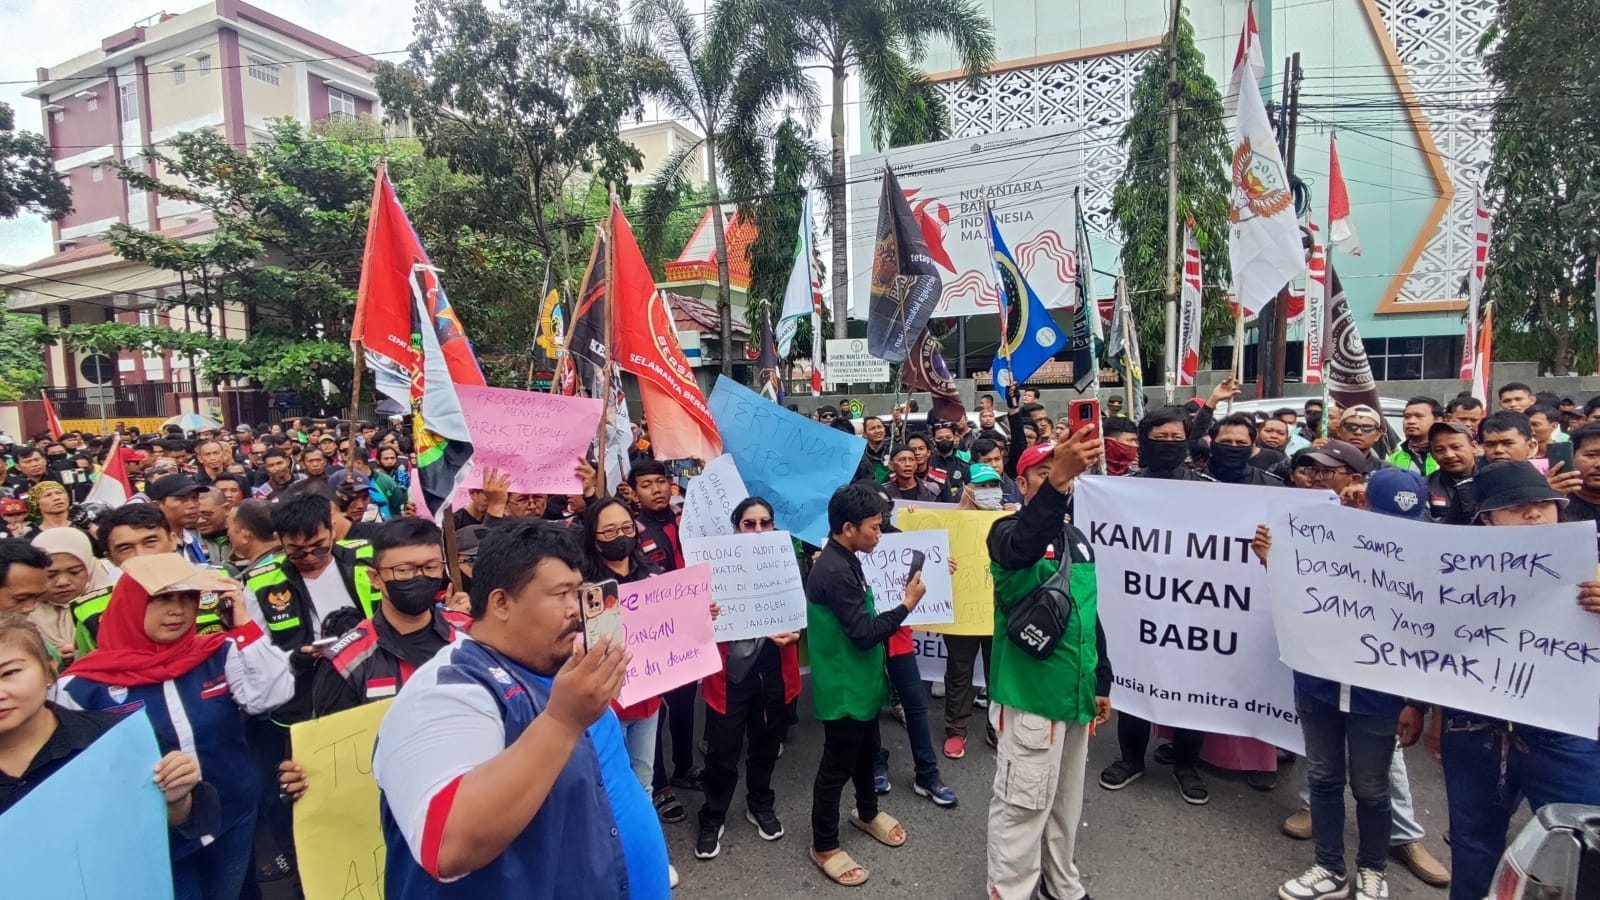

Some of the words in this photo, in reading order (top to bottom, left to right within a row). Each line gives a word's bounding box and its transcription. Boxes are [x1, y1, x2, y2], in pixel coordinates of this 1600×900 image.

[960, 210, 1034, 229] INDNESIA
[960, 230, 986, 241] MA
[1310, 297, 1319, 365] DIRGAHAYU
[629, 353, 683, 395] SELAMANYA
[690, 545, 743, 561] TOLONG
[1090, 520, 1173, 555] KAMI
[1186, 532, 1254, 564] MIT
[856, 547, 897, 569] arga
[711, 565, 747, 576] IKATOR
[1123, 570, 1251, 612] BUKAN
[1371, 567, 1424, 605] Masih
[719, 604, 746, 617] EMO
[755, 601, 786, 613] BOLEH
[743, 617, 784, 630] JANGAN
[1390, 607, 1435, 639] Yang
[330, 631, 361, 653] DRIVER
[1139, 618, 1238, 656] BABU
[912, 639, 948, 659] BEL
[1112, 673, 1145, 694] usia
[1149, 684, 1182, 702] kan
[1187, 691, 1239, 709] mitra
